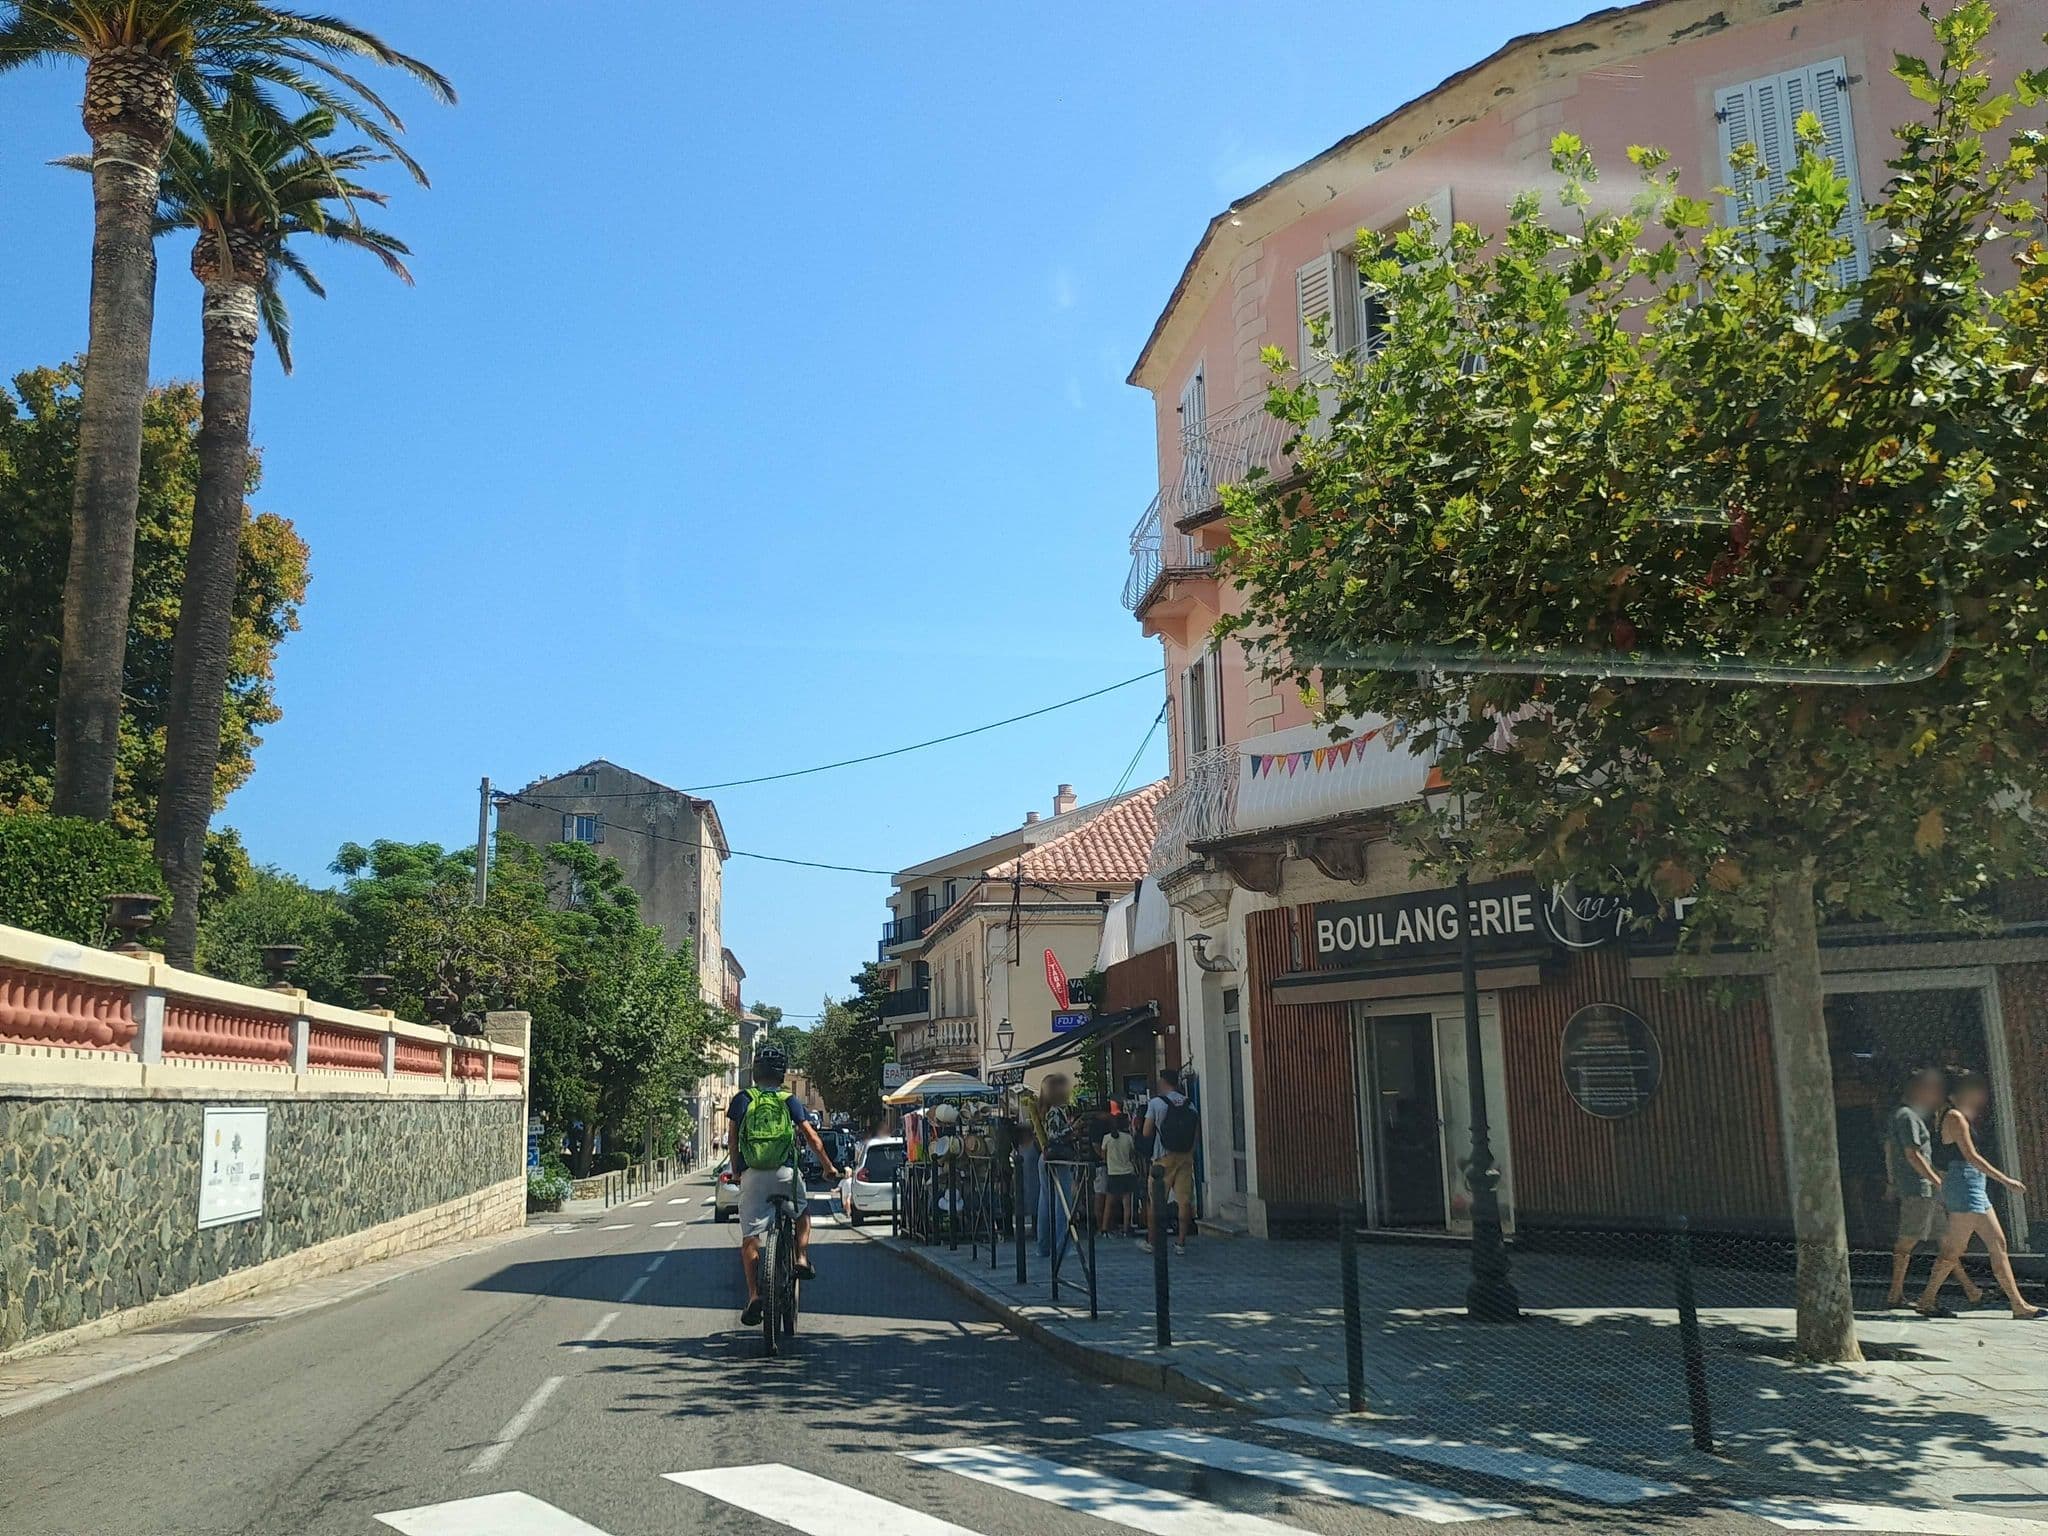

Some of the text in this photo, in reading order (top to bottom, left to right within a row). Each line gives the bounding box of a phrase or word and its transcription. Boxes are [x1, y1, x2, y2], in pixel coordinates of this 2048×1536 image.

[1317, 893, 1535, 954] BOULANGERIE
[1048, 963, 1063, 994] TABAC
[1057, 1017, 1074, 1025] FDJ
[884, 1068, 905, 1079] SPAR
